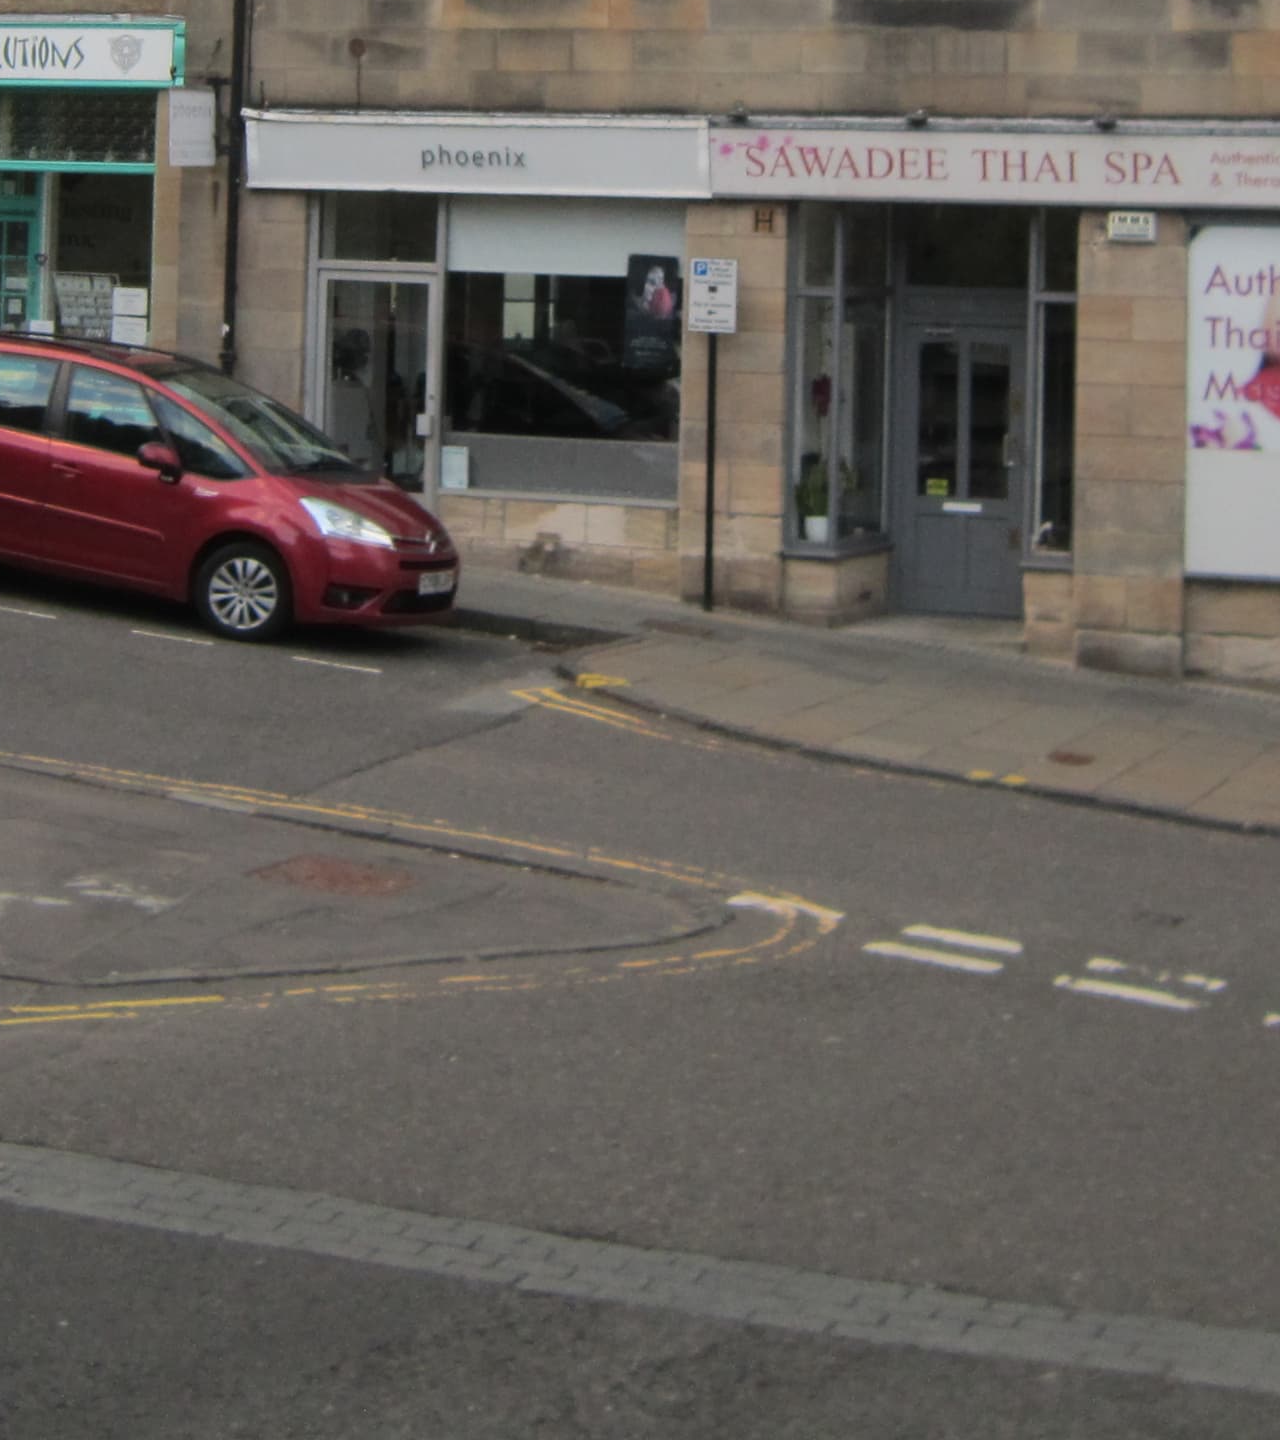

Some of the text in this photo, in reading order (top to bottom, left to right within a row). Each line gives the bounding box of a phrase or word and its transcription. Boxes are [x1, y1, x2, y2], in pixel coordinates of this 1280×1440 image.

[421, 145, 526, 170] phoenix
[745, 146, 1182, 187] SAWADEE THAI SPA
